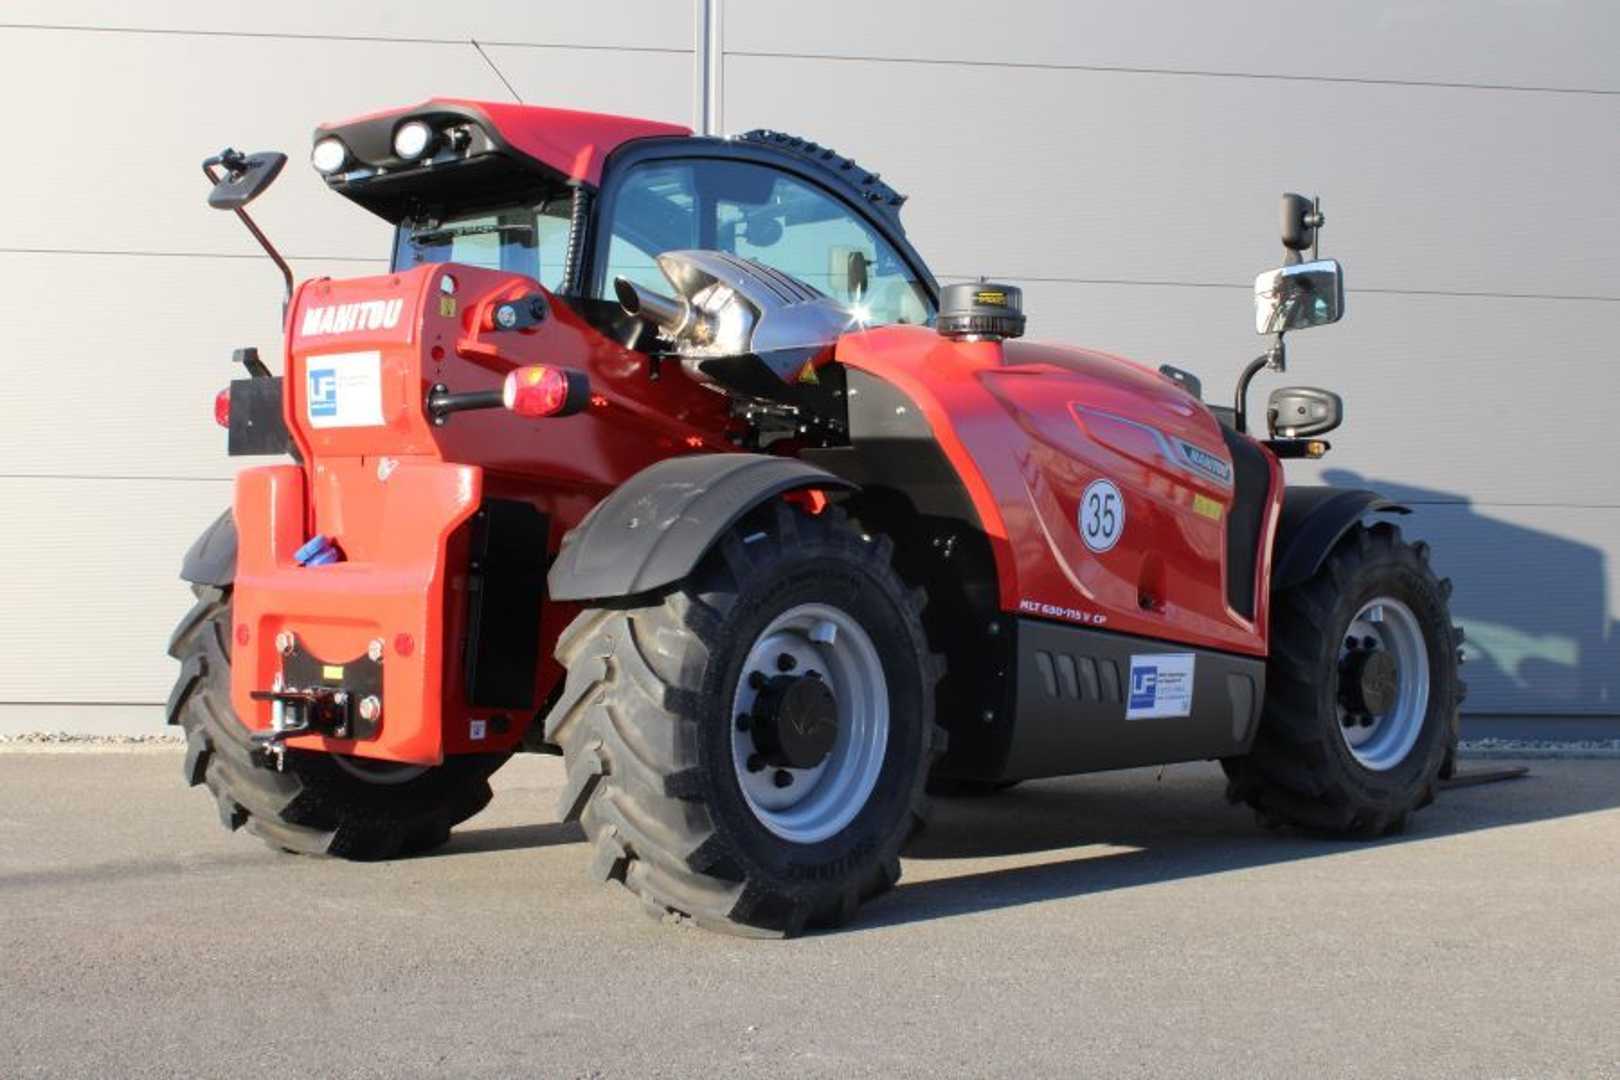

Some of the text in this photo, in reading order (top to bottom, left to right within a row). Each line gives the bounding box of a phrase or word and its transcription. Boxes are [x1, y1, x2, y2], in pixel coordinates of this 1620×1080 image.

[301, 298, 404, 336] MANITOU
[310, 376, 337, 402] LF
[1087, 493, 1115, 538] 35
[1133, 673, 1156, 696] LF
